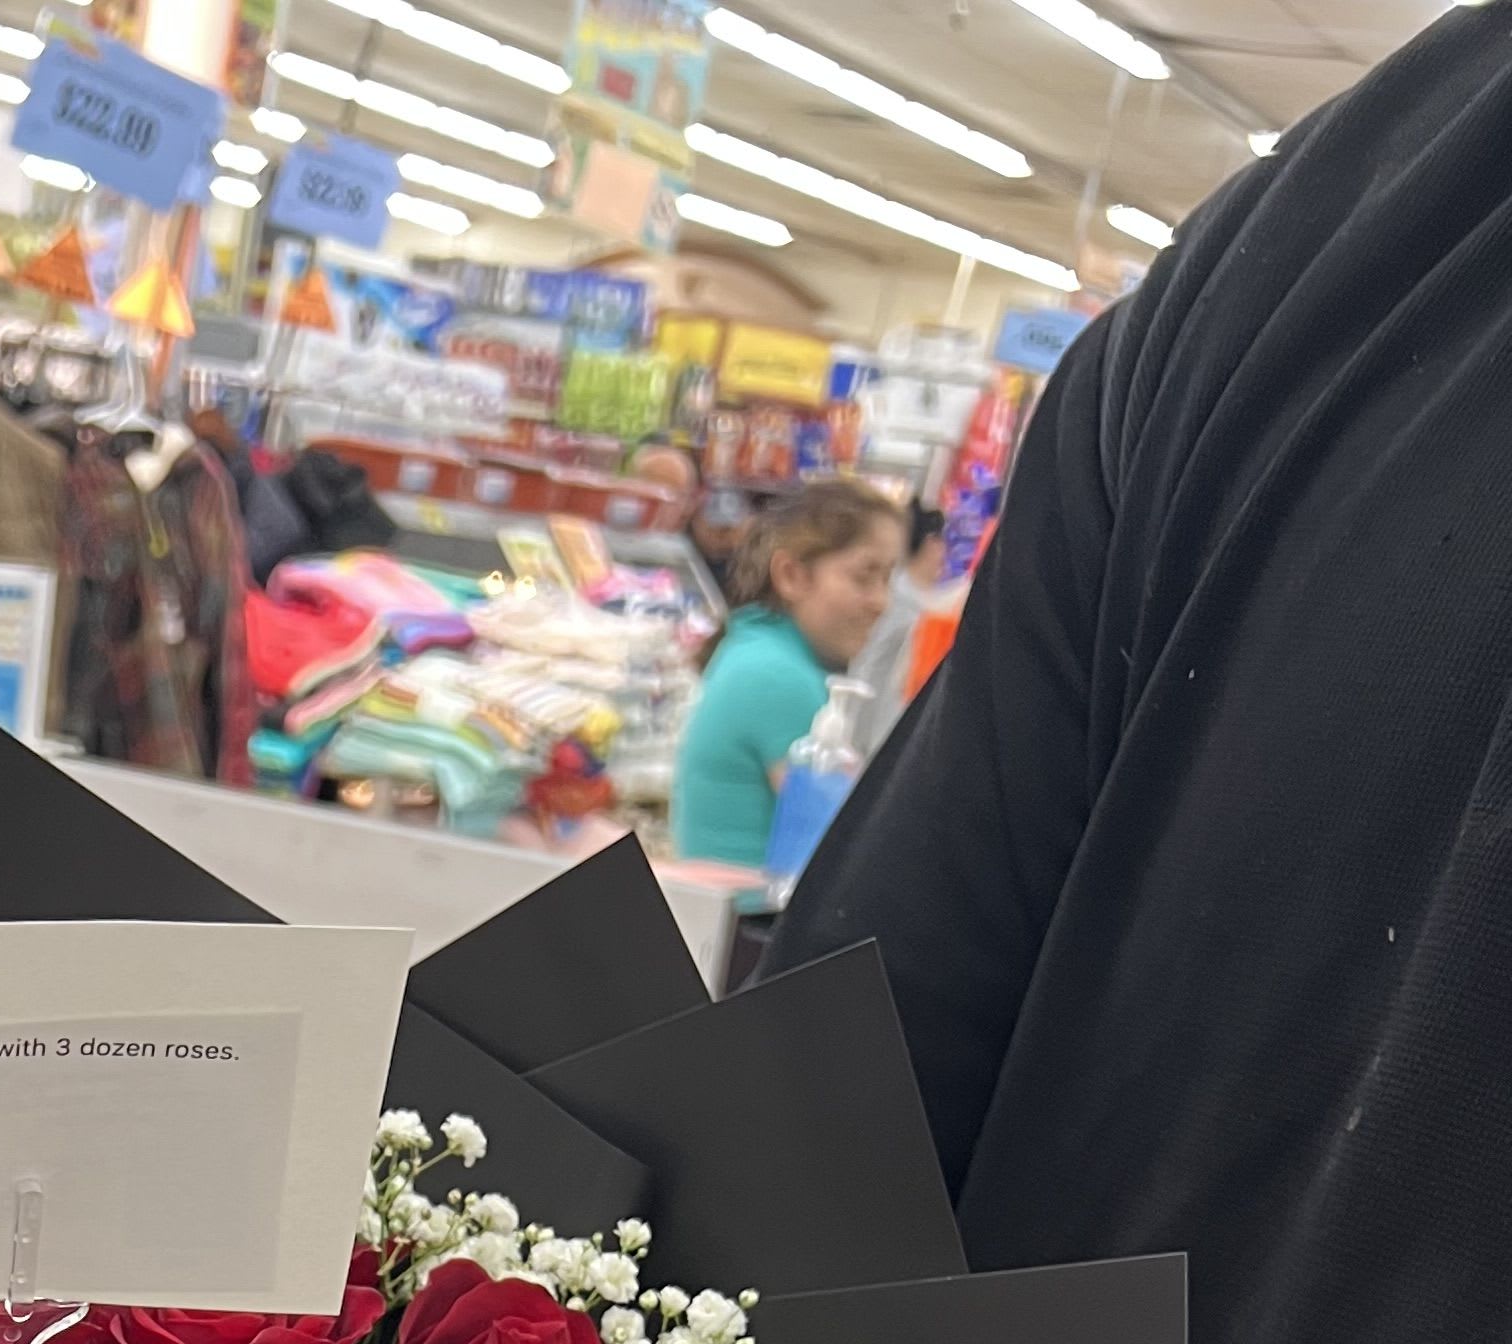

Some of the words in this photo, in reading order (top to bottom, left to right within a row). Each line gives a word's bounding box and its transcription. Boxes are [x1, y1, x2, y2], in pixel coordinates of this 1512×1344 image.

[55, 1037, 71, 1057] 3
[79, 1036, 156, 1058] dozen
[164, 1042, 240, 1061] roses.
